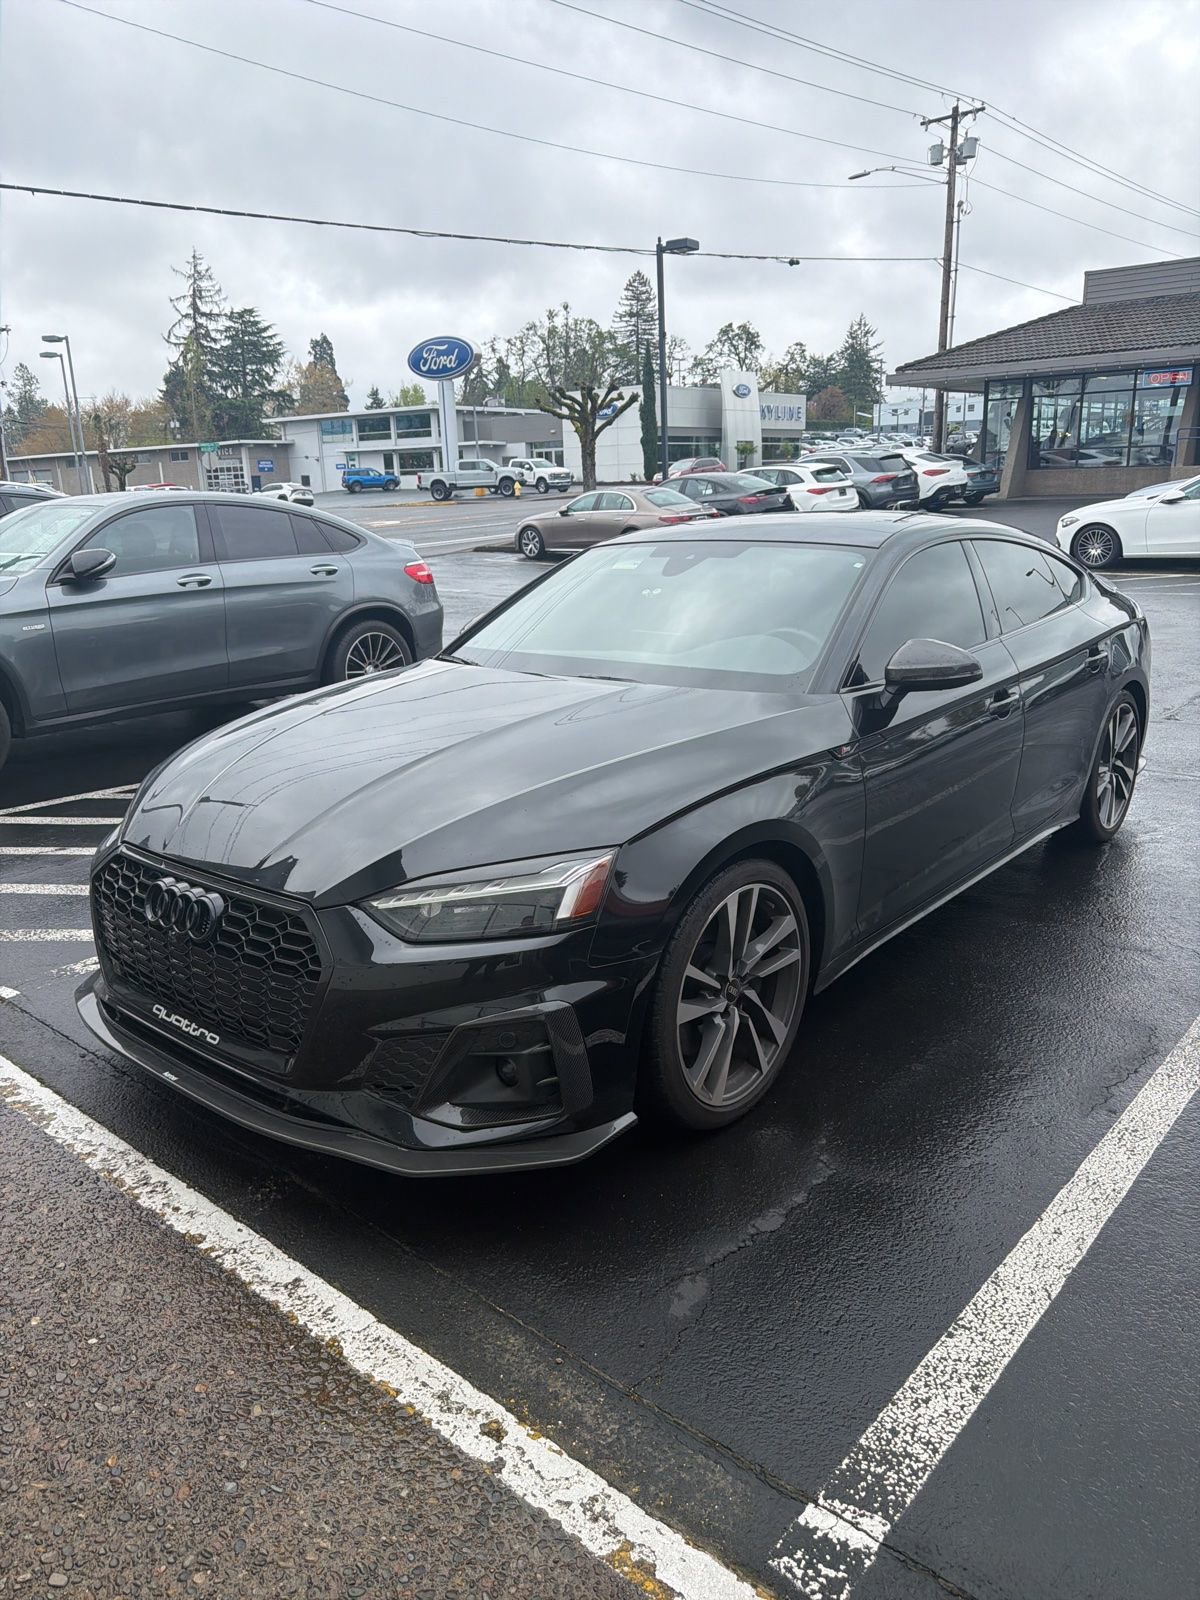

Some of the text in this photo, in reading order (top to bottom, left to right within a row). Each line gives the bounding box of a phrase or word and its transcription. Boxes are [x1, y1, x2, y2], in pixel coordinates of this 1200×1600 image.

[420, 344, 459, 372] Ford
[1150, 371, 1188, 384] OPEN
[760, 404, 803, 421] KYLINE
[152, 1004, 220, 1045] quattro
